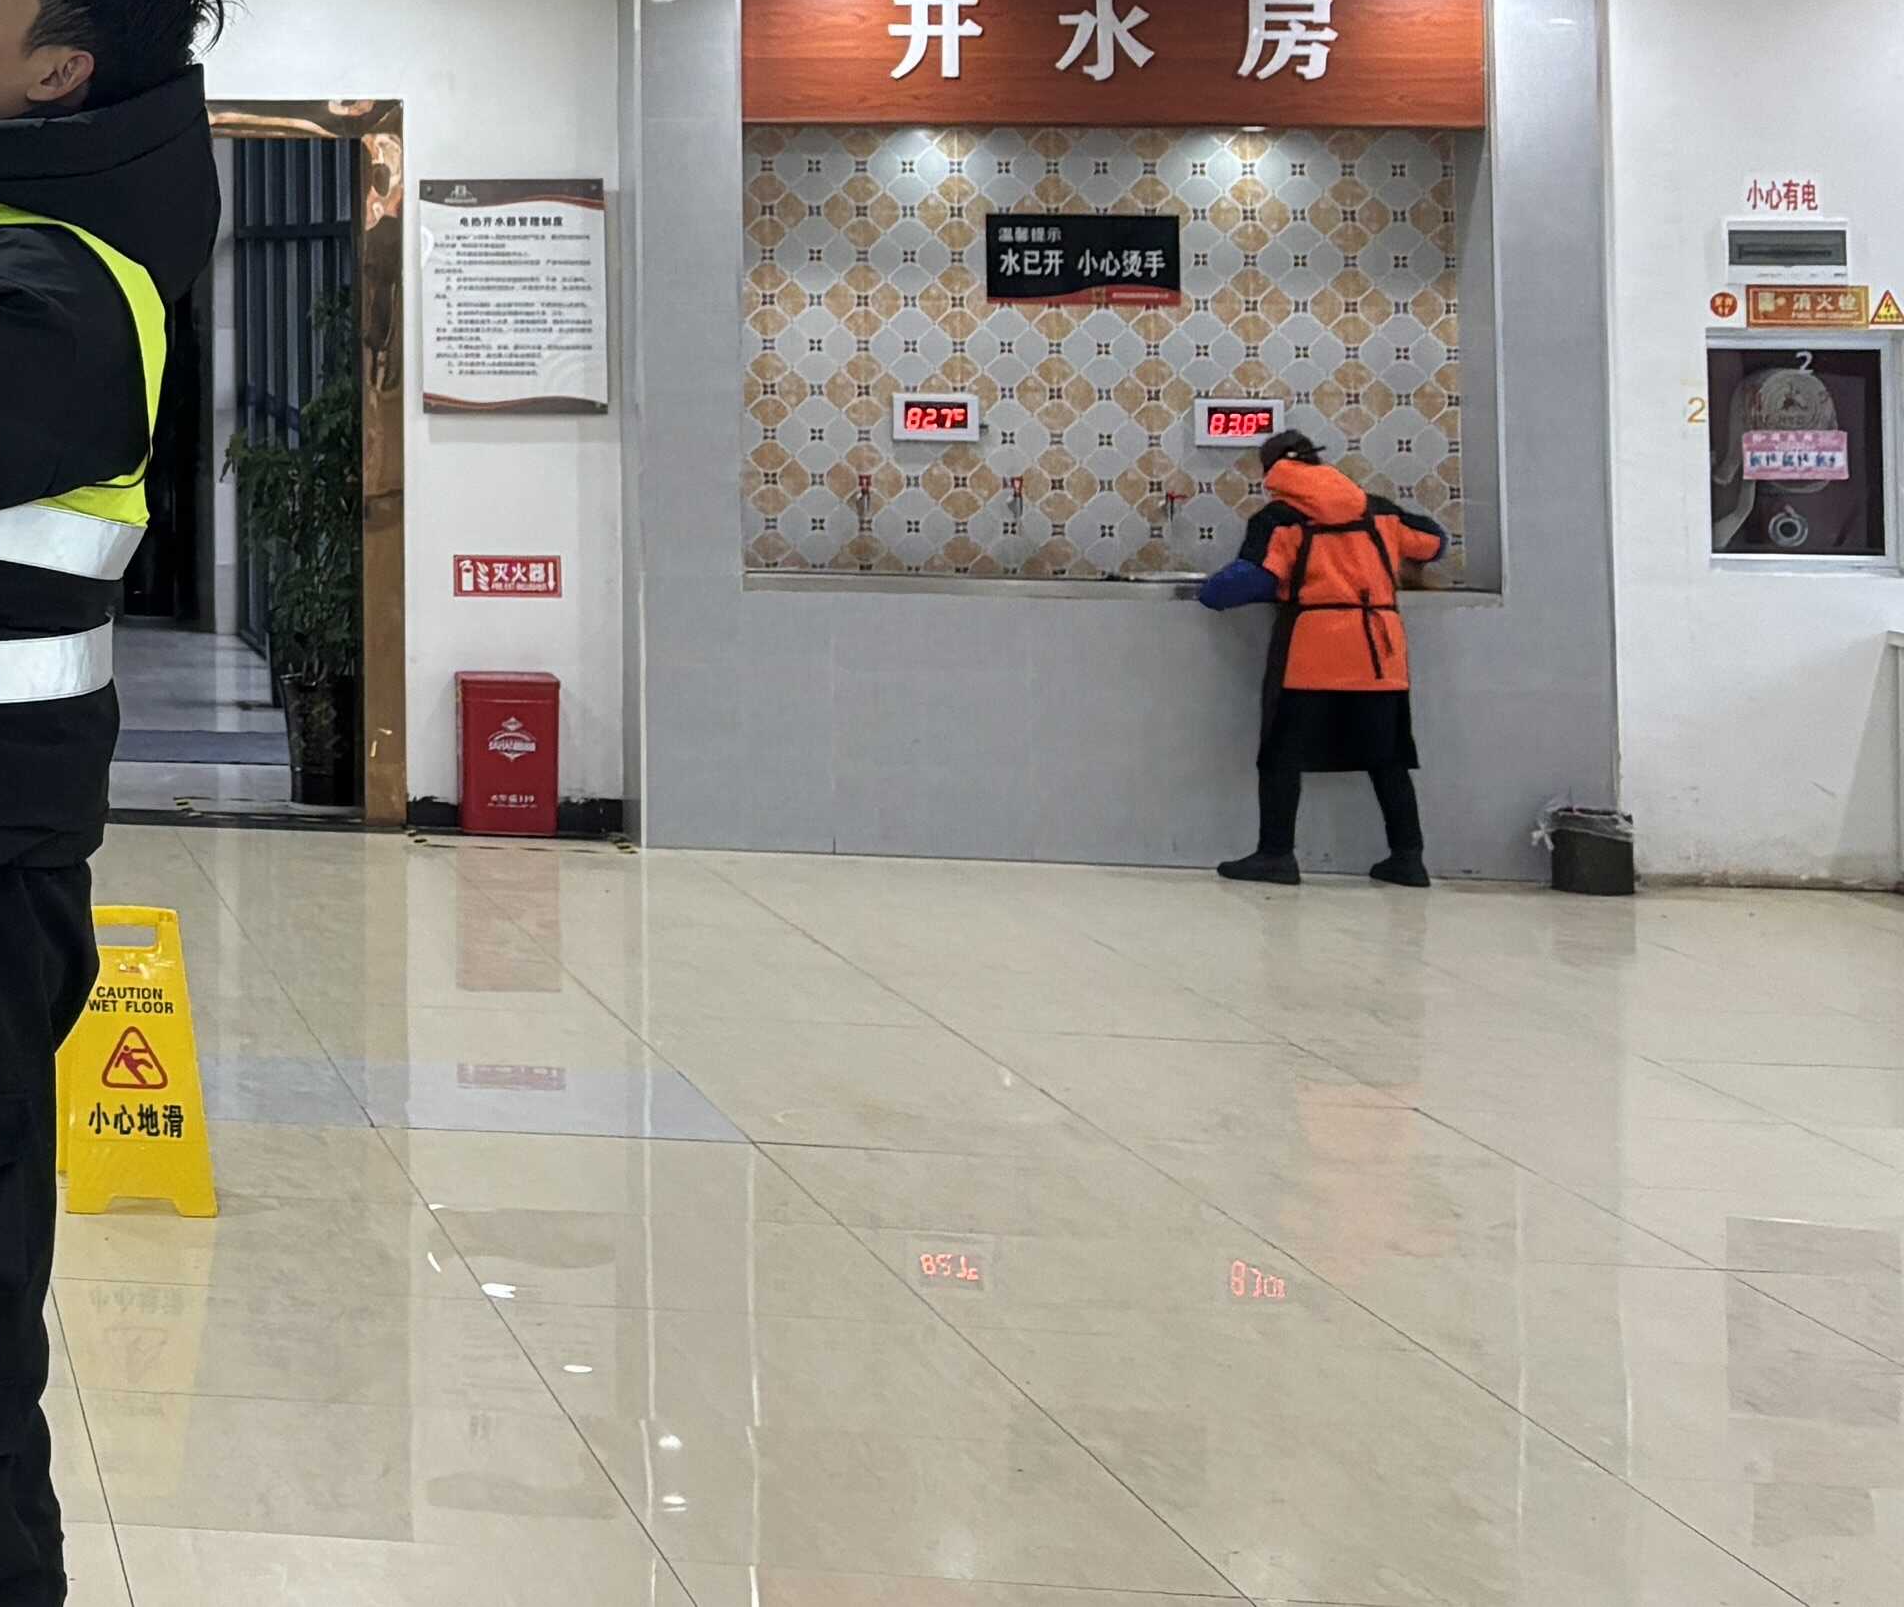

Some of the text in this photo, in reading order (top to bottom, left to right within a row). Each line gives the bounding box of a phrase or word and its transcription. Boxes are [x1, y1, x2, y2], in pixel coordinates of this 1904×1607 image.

[1746, 179, 1818, 211] 小心有电
[999, 248, 1167, 278] 水已开 小心烫手
[1796, 351, 1813, 373] 2
[1688, 397, 1706, 423] 2
[492, 562, 545, 582] 灭火器
[96, 986, 163, 1001] CAUTION
[88, 999, 175, 1014] WET FLOOR
[88, 1103, 184, 1138] 小心地滑
